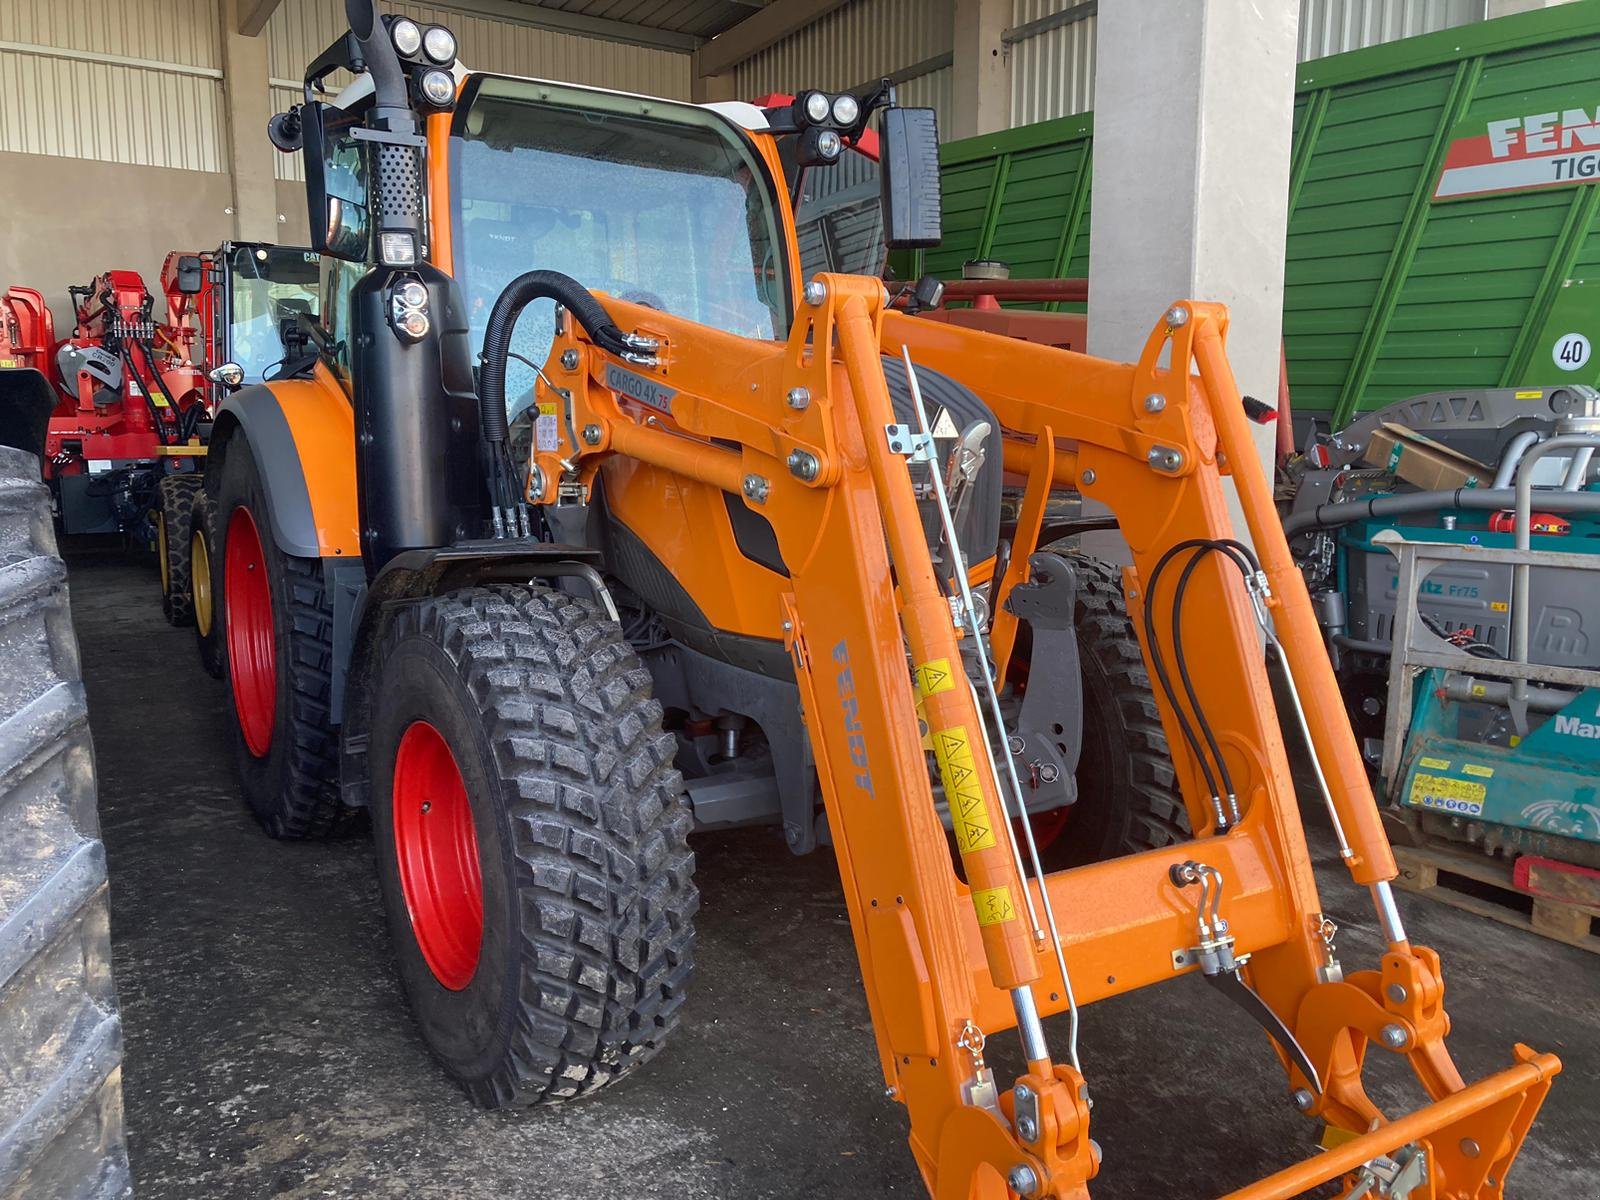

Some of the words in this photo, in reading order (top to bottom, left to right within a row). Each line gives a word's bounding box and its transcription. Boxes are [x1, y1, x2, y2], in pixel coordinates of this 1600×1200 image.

[1552, 155, 1600, 180] TIG
[303, 251, 320, 263] CAT
[1560, 340, 1583, 363] 40
[609, 369, 642, 397] CARGO
[643, 383, 657, 404] 4X
[658, 394, 669, 409] 75
[1448, 584, 1479, 599] Fr75
[832, 639, 874, 799] FENDT
